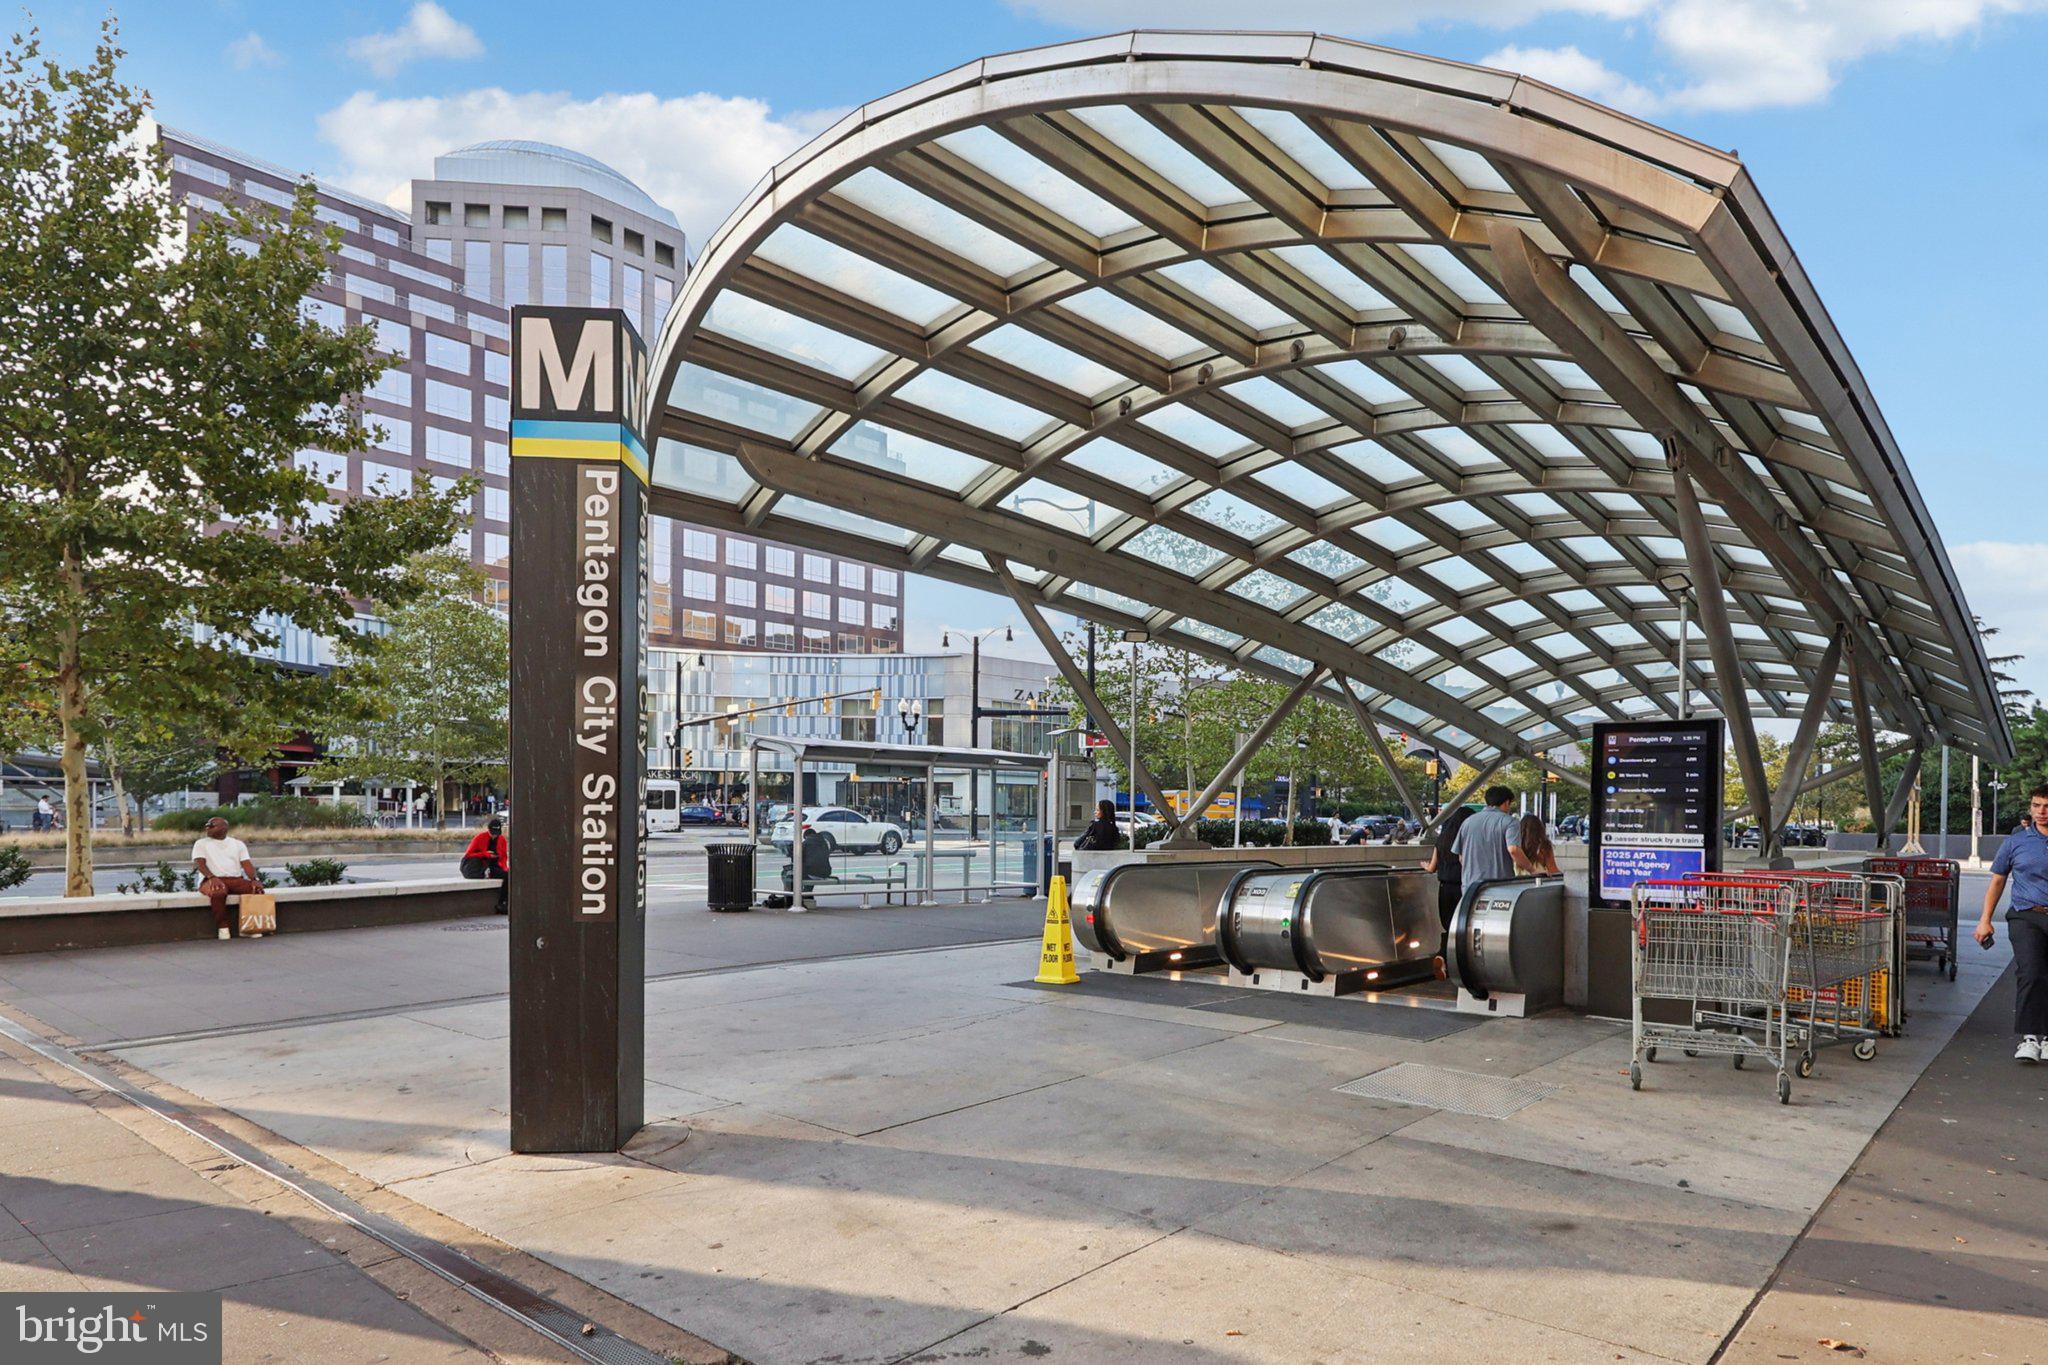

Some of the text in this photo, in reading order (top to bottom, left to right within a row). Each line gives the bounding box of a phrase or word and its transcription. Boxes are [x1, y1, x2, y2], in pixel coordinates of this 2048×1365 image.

[521, 317, 614, 412] M
[622, 326, 646, 441] M
[576, 470, 618, 915] Pentagon City Station
[637, 490, 649, 909] Pentagon City Station
[1629, 736, 1659, 744] Pentagon
[1665, 837, 1674, 845] by
[1606, 851, 1657, 860] 2025 APTA
[1606, 860, 1671, 870] Transit Agency
[1616, 868, 1631, 876] the
[1633, 869, 1652, 877] Year
[1046, 943, 1056, 952] WET
[1043, 954, 1058, 963] FLOOR
